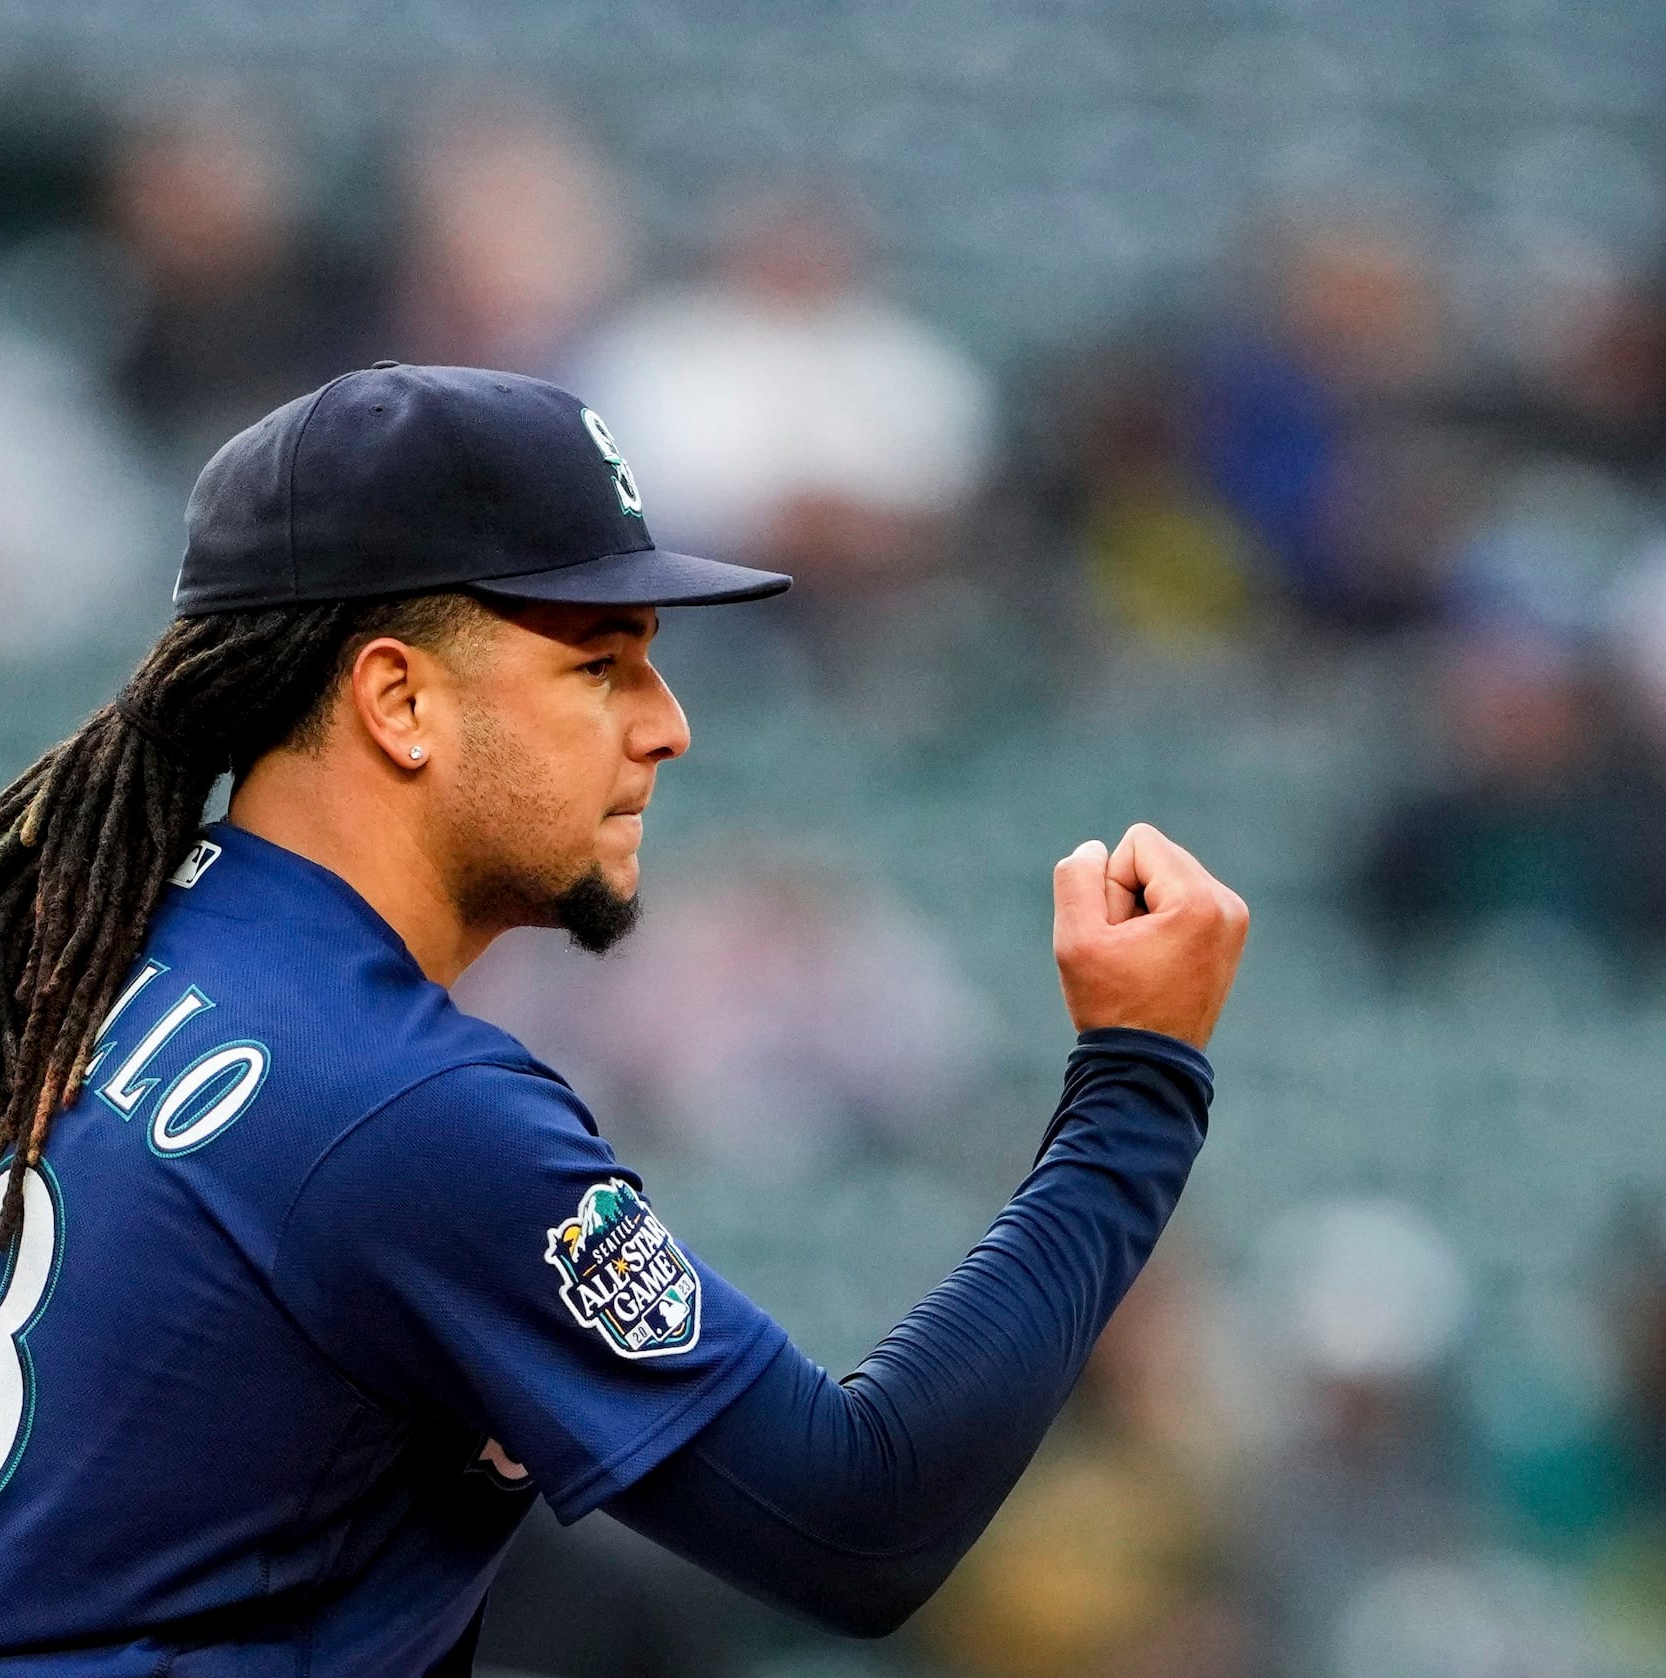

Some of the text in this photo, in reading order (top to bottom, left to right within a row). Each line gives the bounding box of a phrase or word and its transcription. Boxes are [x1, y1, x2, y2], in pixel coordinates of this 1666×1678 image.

[576, 1215, 667, 1317] ALL STAR
[592, 1215, 636, 1265] SEATTLE
[613, 1250, 677, 1322] GAME
[633, 1326, 648, 1344] 20
